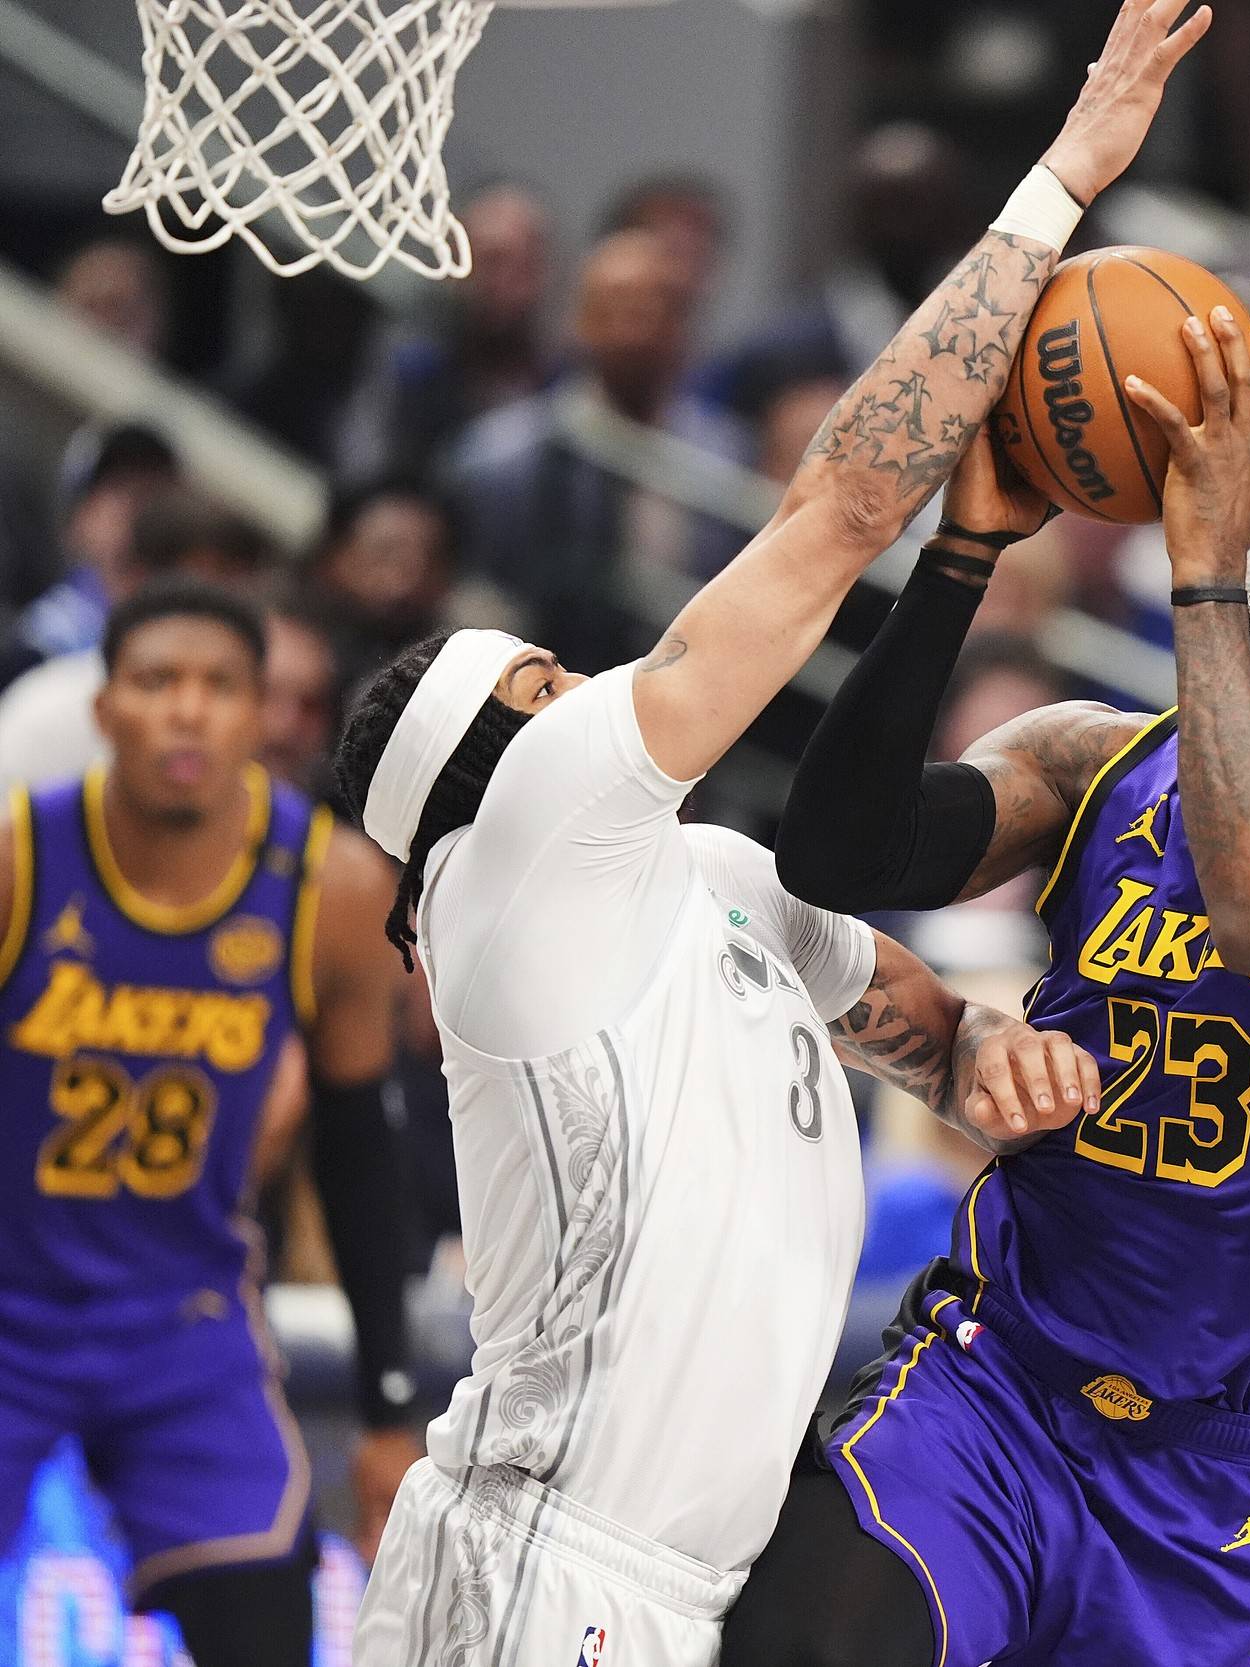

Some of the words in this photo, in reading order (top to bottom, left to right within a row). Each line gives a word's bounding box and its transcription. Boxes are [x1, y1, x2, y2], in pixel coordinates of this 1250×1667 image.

[1037, 318, 1116, 501] Wilson
[36, 1056, 218, 1198] 28
[789, 1021, 824, 1144] 3
[1085, 1380, 1147, 1419] LAKERS
